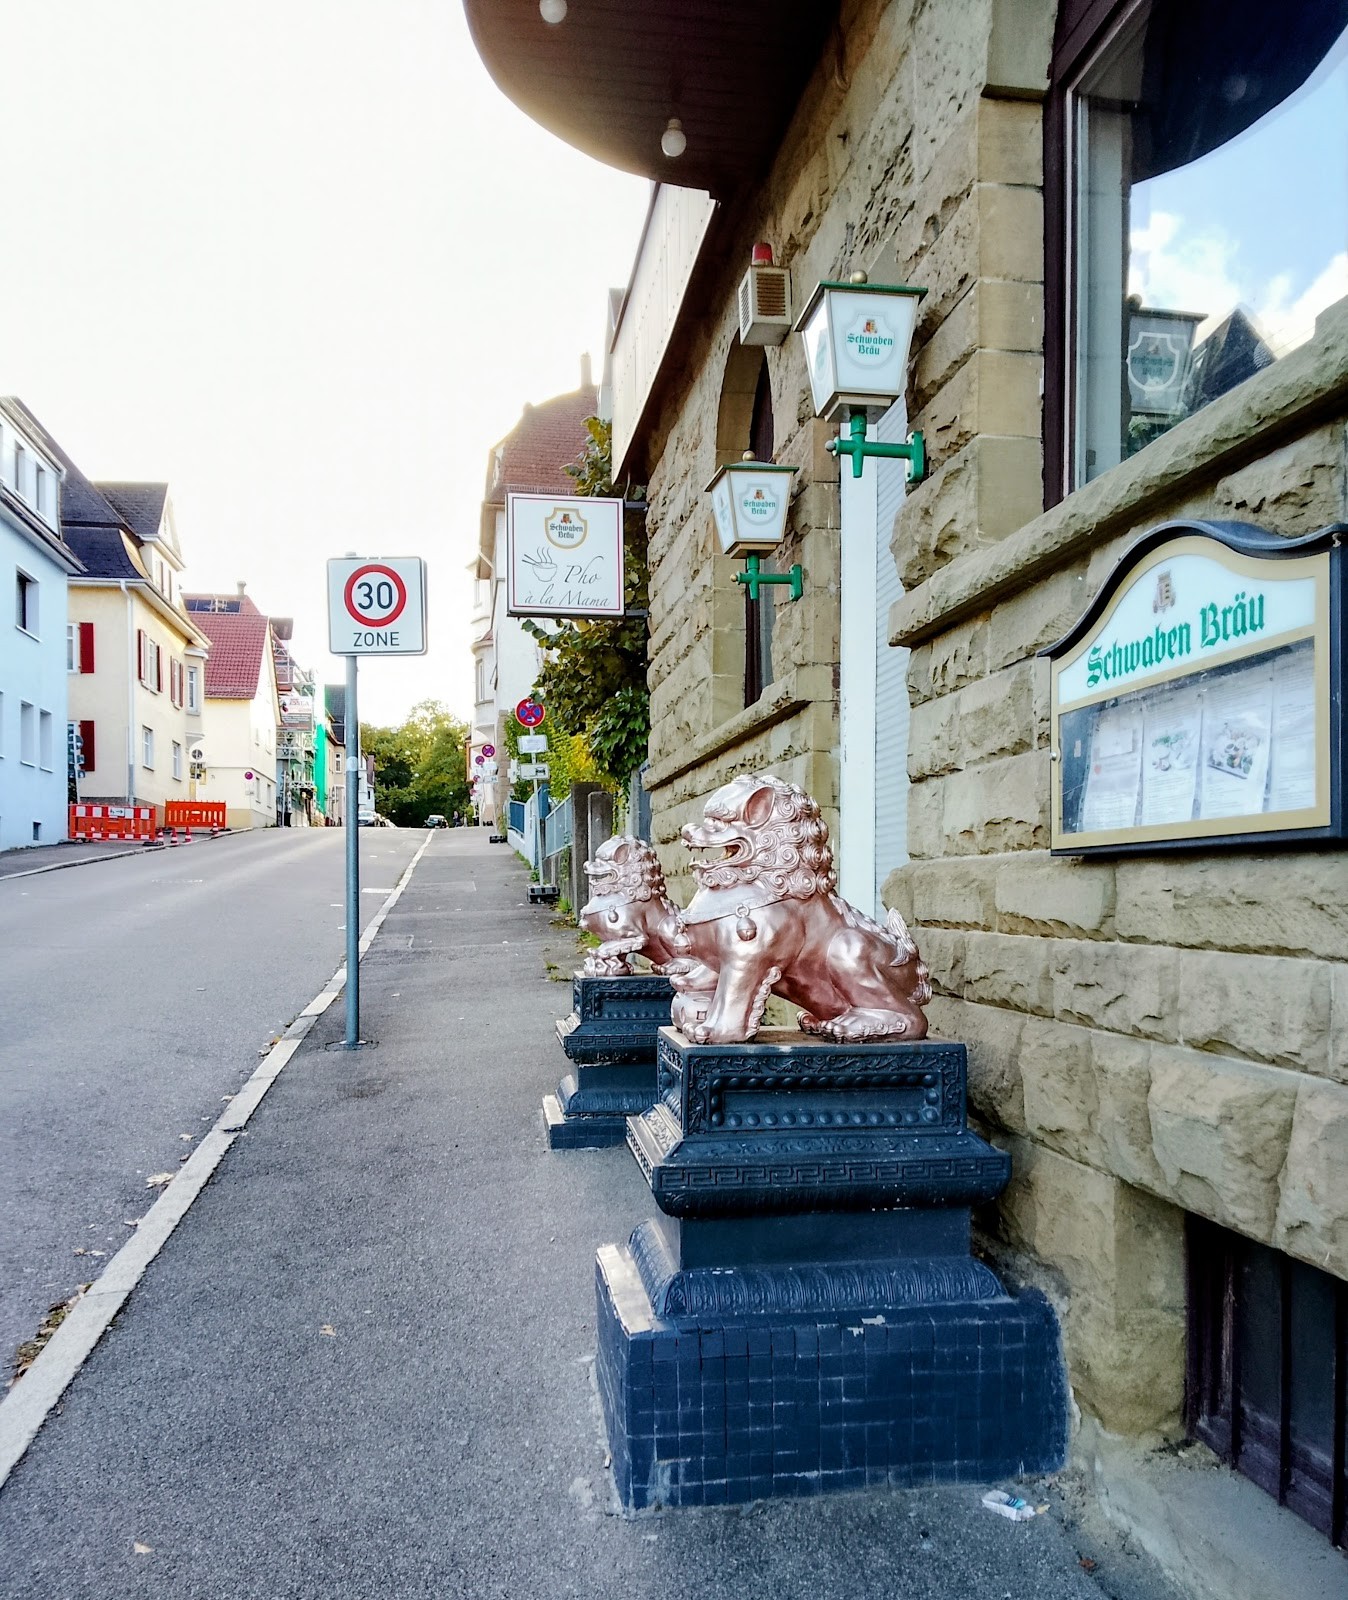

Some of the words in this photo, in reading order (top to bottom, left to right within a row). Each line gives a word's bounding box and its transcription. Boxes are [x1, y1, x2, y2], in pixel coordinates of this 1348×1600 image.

[847, 333, 893, 346] Schwaben
[858, 344, 880, 355] Bräu
[549, 523, 584, 532] Schwaben
[564, 555, 604, 584] Pho
[357, 581, 393, 610] 30
[539, 583, 555, 604] la
[558, 590, 610, 607] Mama
[353, 631, 400, 647] ZONE
[1086, 621, 1192, 689] Schwaben
[1200, 591, 1265, 649] Bräu
